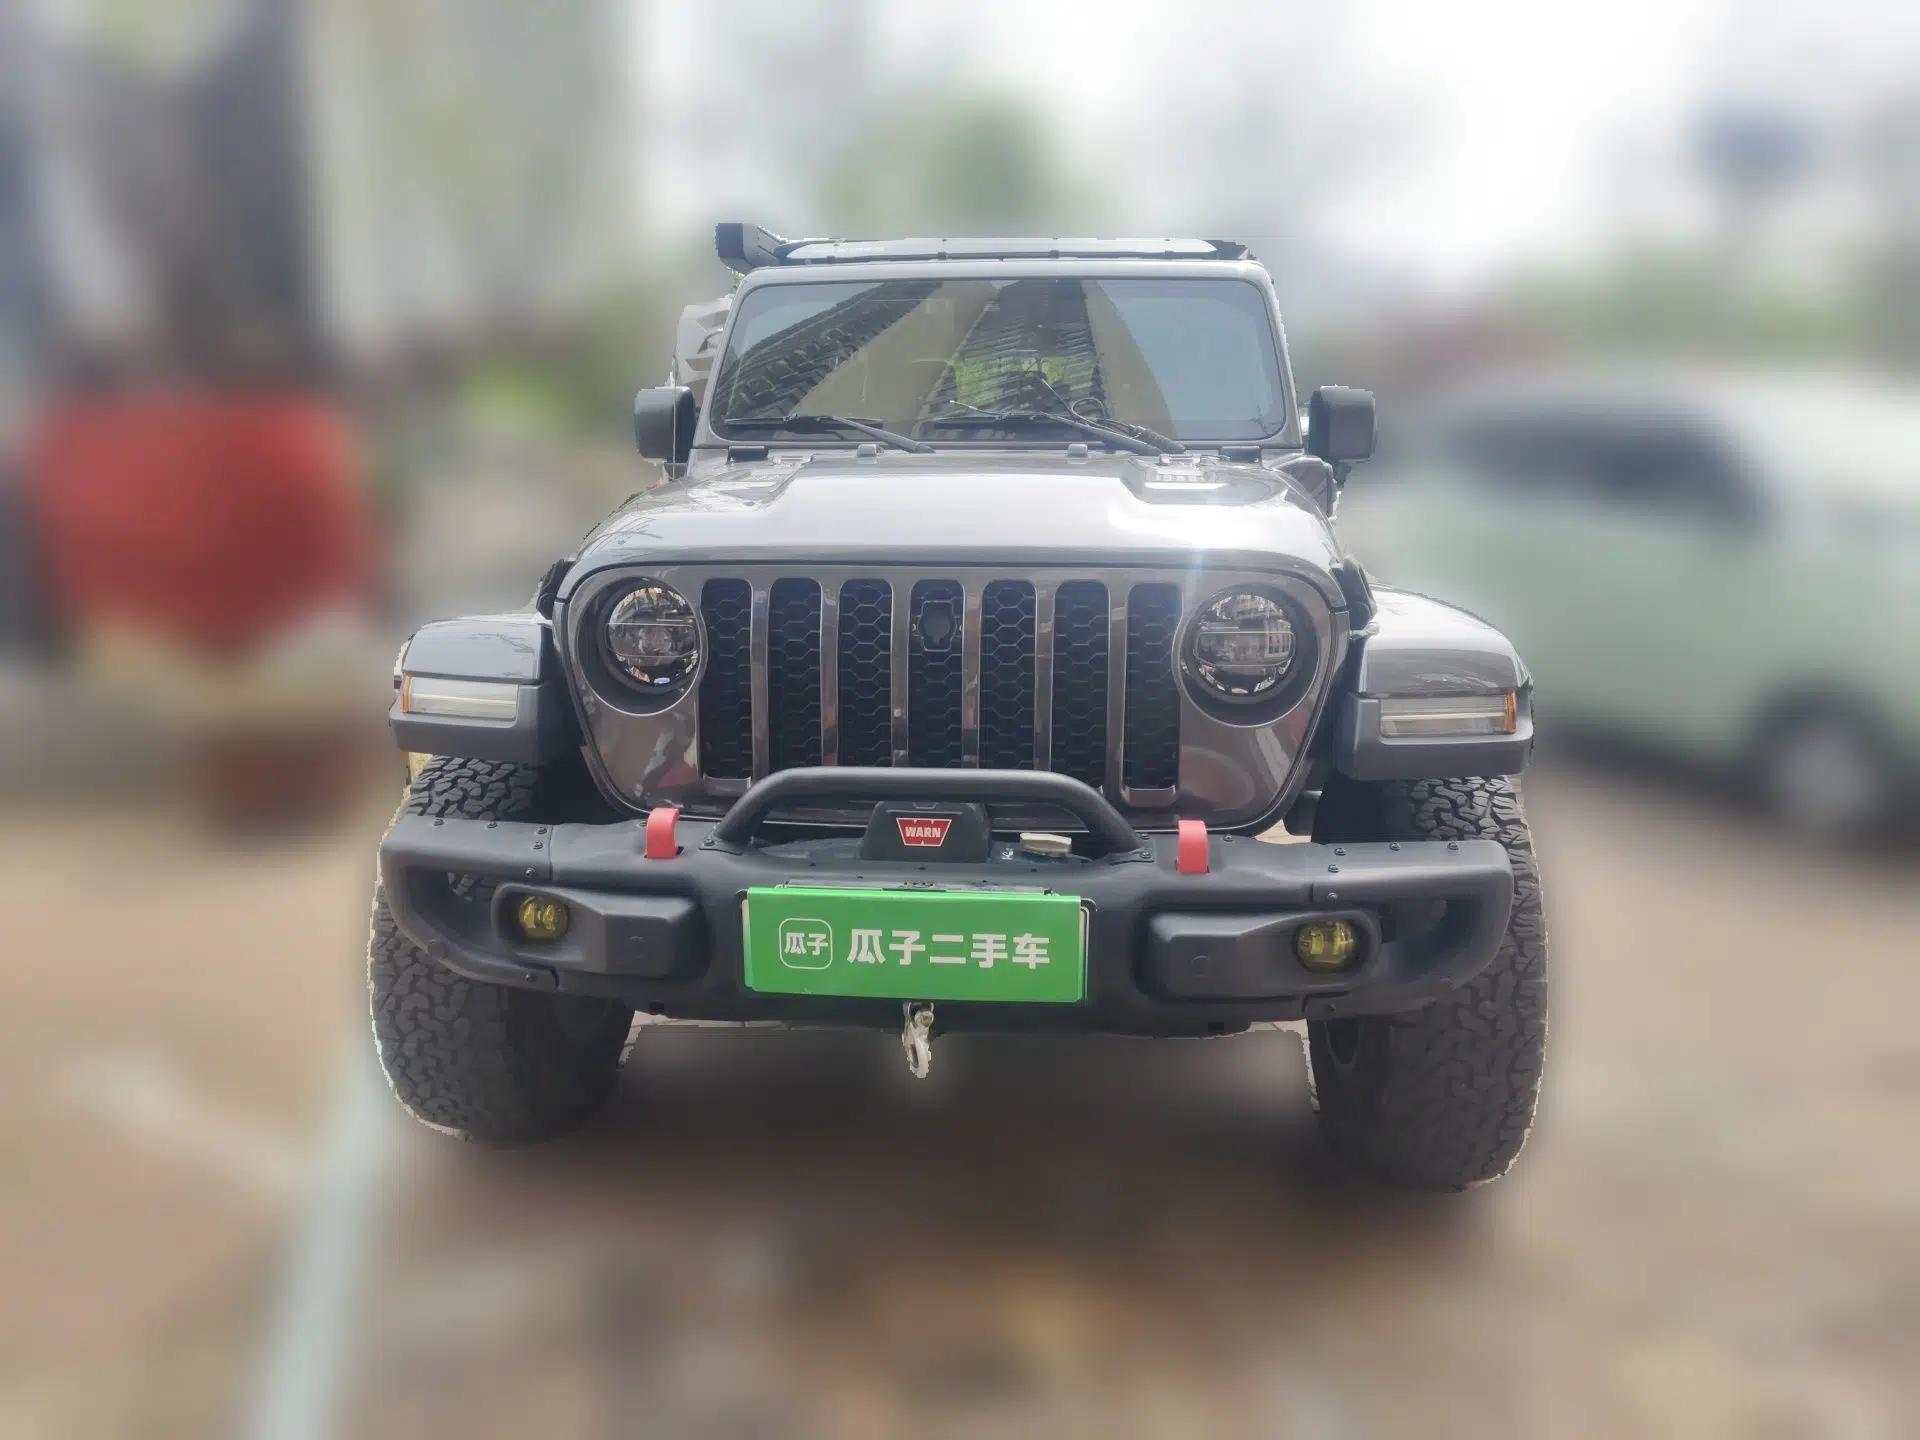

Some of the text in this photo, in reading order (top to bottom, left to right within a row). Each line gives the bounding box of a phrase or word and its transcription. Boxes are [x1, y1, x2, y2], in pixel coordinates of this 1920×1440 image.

[905, 826, 941, 838] WARN
[784, 932, 828, 956] 瓜子
[847, 928, 1050, 969] 瓜子二手车
